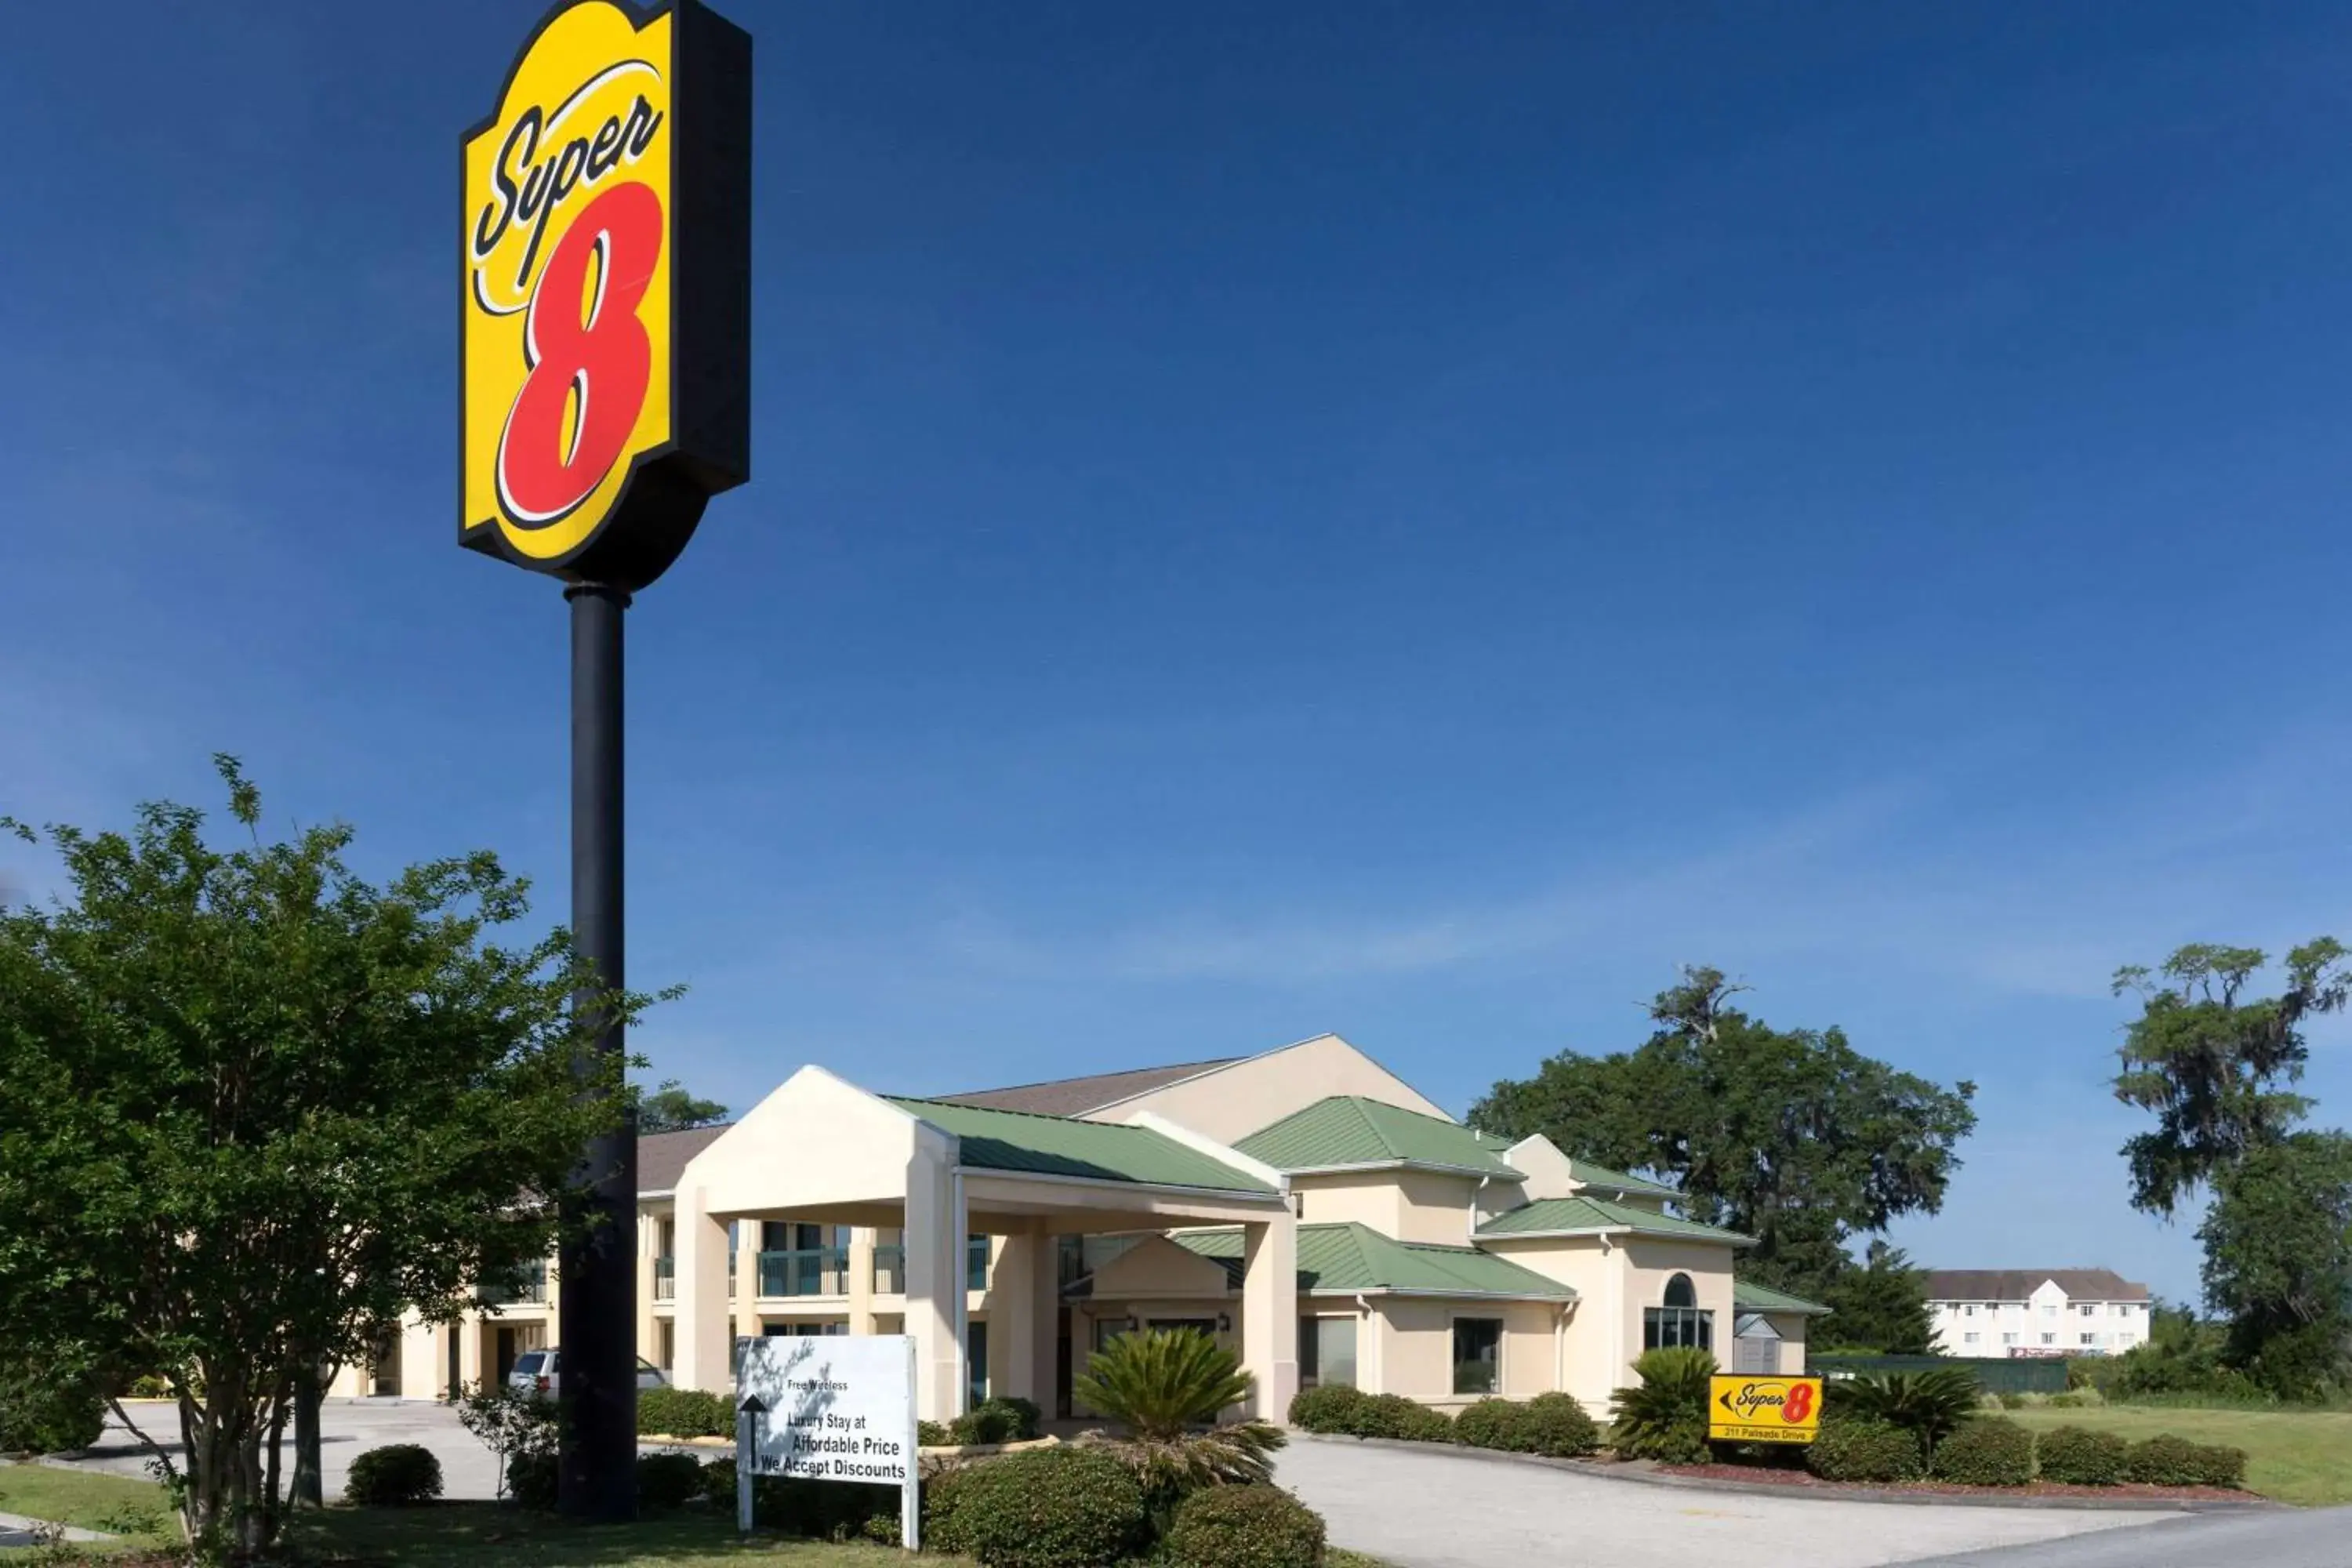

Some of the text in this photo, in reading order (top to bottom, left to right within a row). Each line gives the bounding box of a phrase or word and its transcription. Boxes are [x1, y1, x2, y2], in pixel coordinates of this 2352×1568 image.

[474, 93, 664, 292] Super
[495, 181, 663, 528] 8
[787, 1379, 807, 1390] Free
[1736, 1382, 1813, 1425] Super 8
[787, 1411, 866, 1432] Luxury Stay at
[793, 1435, 900, 1456] Affordable Price
[1724, 1428, 1739, 1437] 211
[1782, 1429, 1806, 1440] Drive
[761, 1454, 906, 1479] We Accept Discounts
